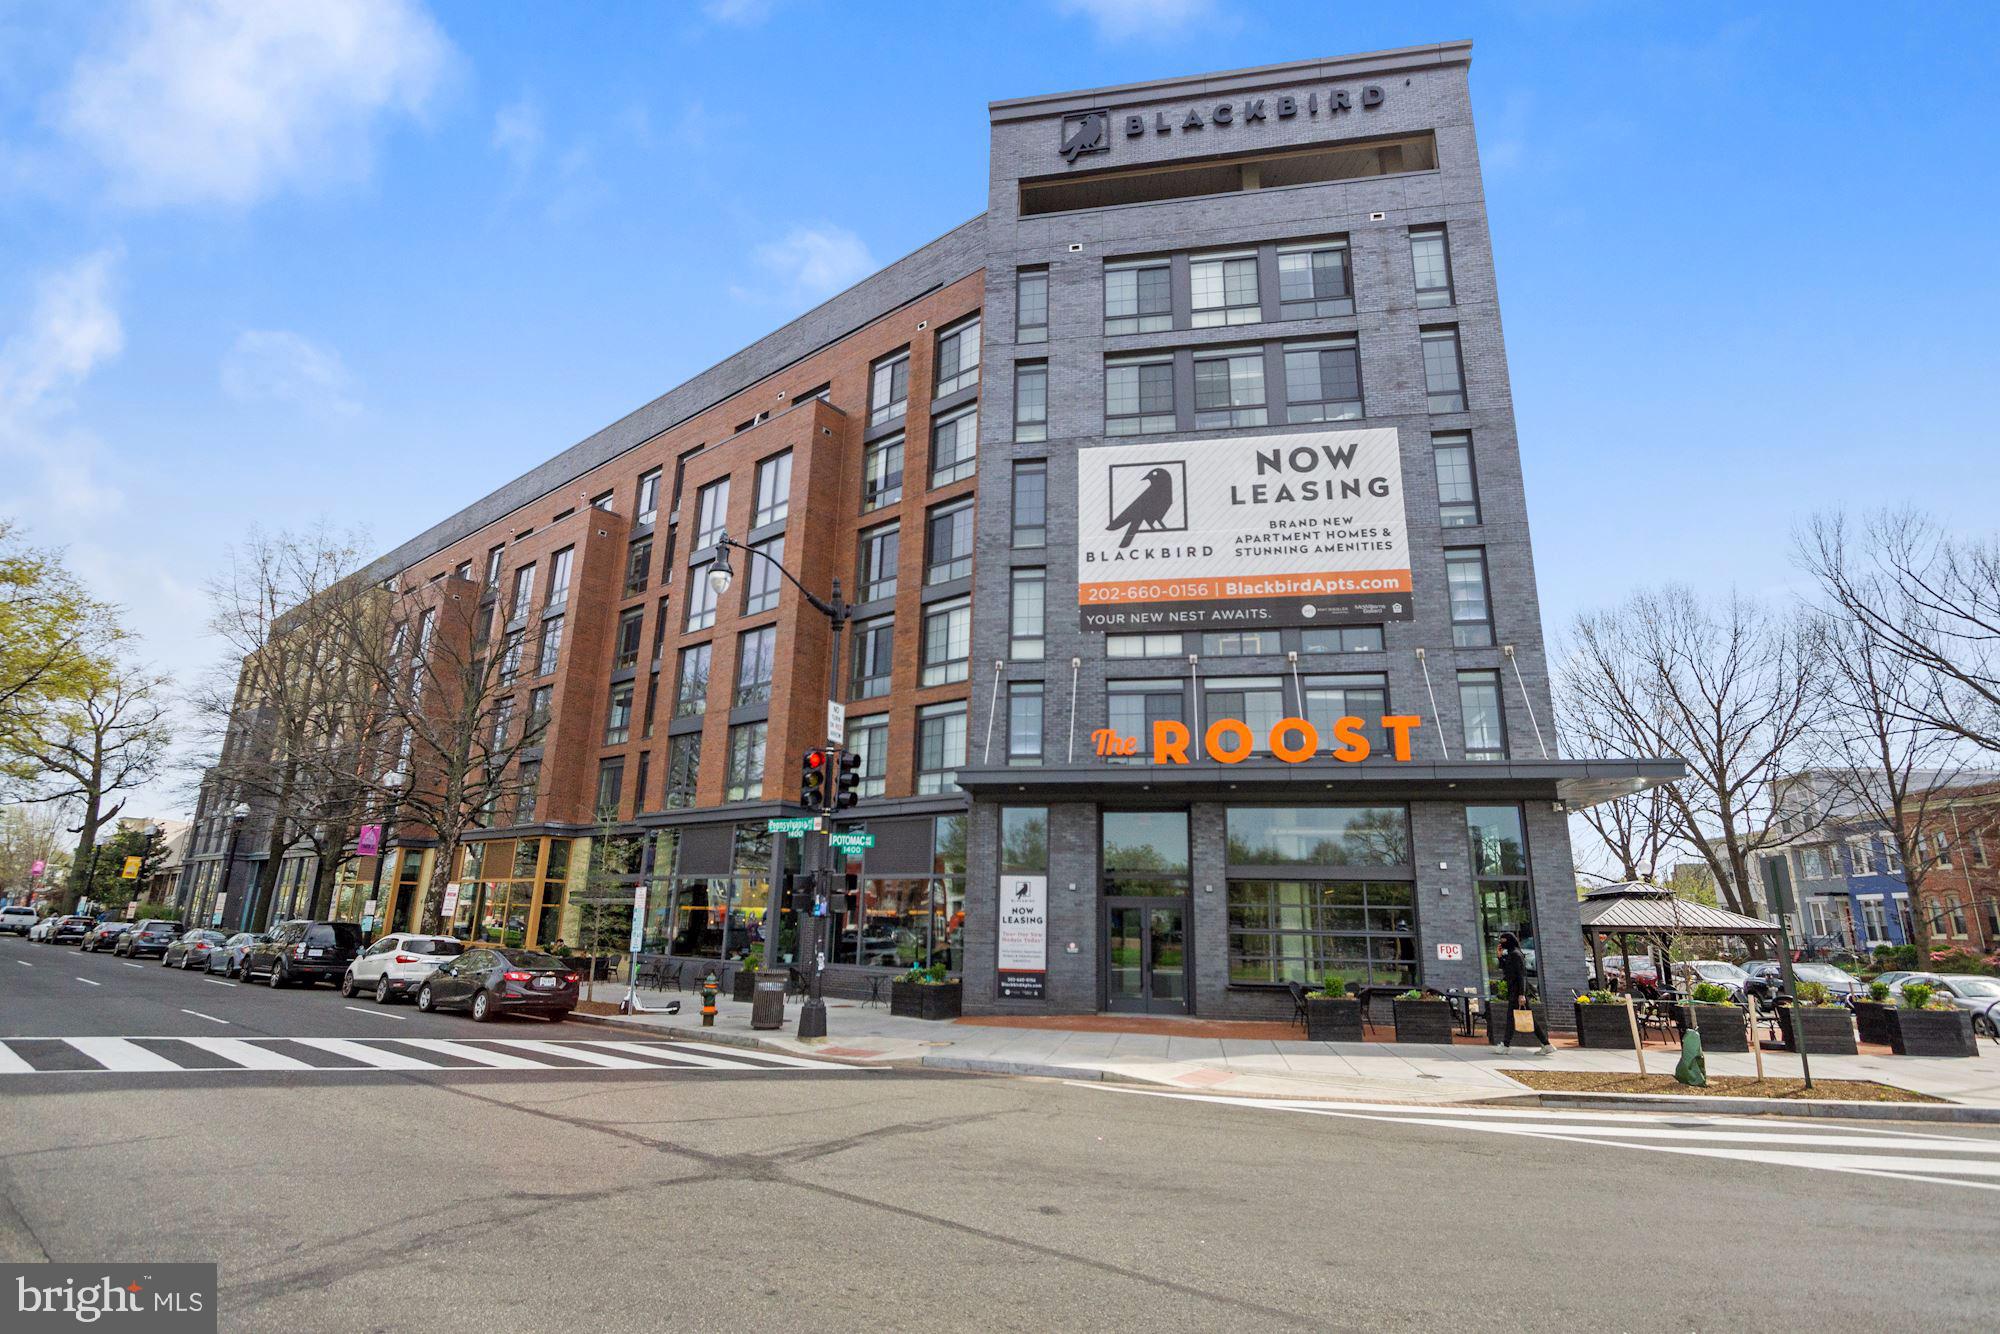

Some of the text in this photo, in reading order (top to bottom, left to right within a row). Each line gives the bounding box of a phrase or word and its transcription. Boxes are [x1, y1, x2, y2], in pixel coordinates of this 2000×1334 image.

[1125, 85, 1386, 137] BLACKBIRD
[1256, 443, 1358, 475] NOW
[1231, 477, 1390, 505] LEASING
[1269, 516, 1354, 529] BRAND NEW
[1235, 527, 1392, 544] APARTMENT HOMES &
[1086, 546, 1213, 562] BLACKBIRD
[1235, 541, 1393, 557] STUNNING AMENITIES
[1089, 577, 1399, 601] 202-660-0156 BlackbirdApts.com
[1086, 608, 1272, 625] YOUR NEW NEST AWAITS.
[1091, 715, 1421, 764] The ROOST
[788, 830, 804, 838] 1400
[832, 835, 865, 846] POTOMAC
[843, 846, 861, 854] 1400
[1012, 907, 1034, 915] NOW
[1002, 916, 1043, 924] LEASING
[1440, 945, 1459, 955] FDC
